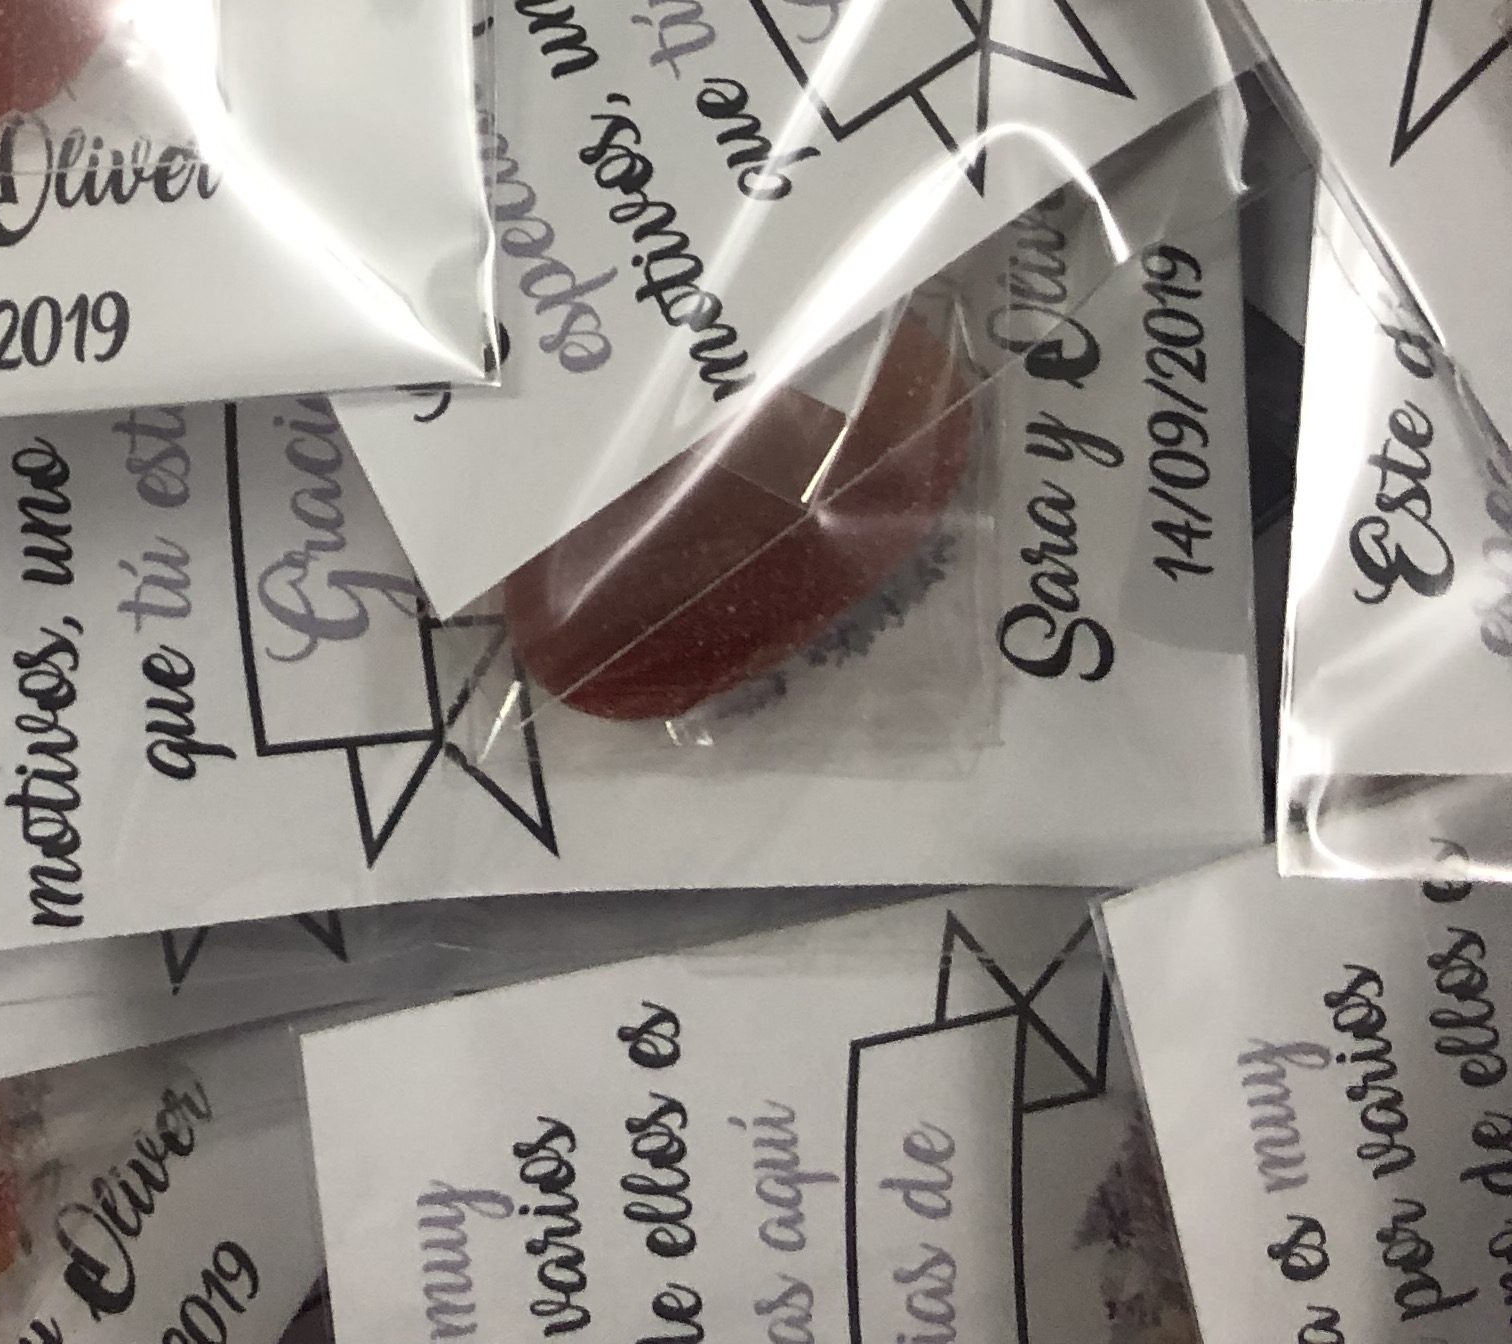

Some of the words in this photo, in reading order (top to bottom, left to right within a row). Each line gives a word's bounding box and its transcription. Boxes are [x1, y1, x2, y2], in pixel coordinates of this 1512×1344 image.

[1024, 412, 1125, 468] y
[1140, 242, 1215, 584] 14/09/2019
[13, 435, 76, 586] uno
[999, 478, 1115, 682] Sara
[1348, 400, 1455, 605] Este
[117, 535, 194, 638] tú
[4, 614, 87, 929] motivos,
[144, 643, 238, 781] que
[616, 1000, 682, 1069] es
[1323, 963, 1417, 1180] varios
[1426, 926, 1508, 1088] ellos
[619, 1090, 698, 1258] ellos
[727, 1099, 841, 1252] aquí
[877, 1120, 958, 1221] de
[1237, 1037, 1332, 1195] muy
[55, 1080, 213, 1322] Oliver
[416, 1179, 516, 1340] muy
[512, 1116, 591, 1338] varios
[1267, 1214, 1330, 1282] es
[1376, 1197, 1481, 1323] por
